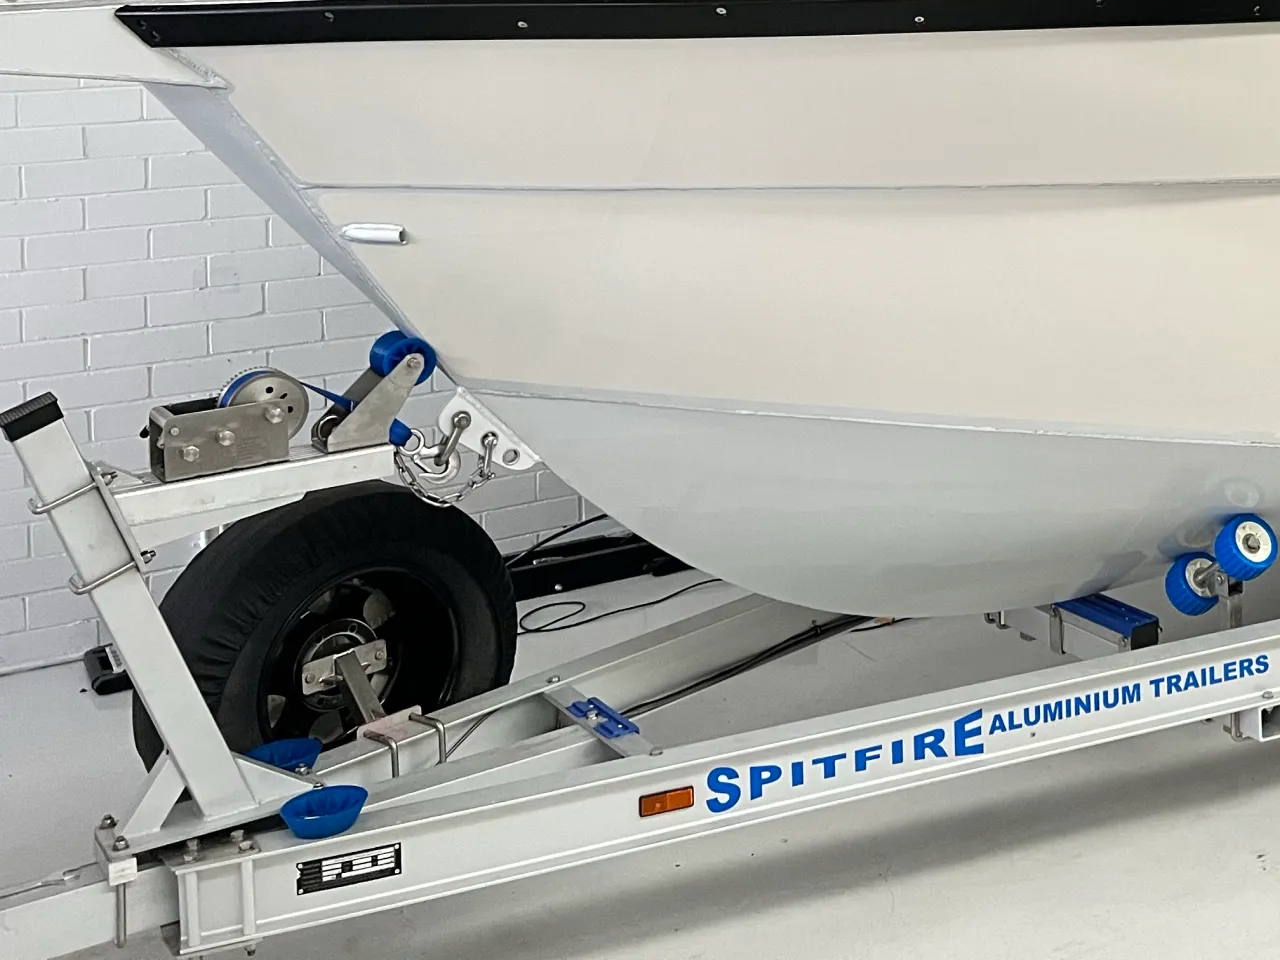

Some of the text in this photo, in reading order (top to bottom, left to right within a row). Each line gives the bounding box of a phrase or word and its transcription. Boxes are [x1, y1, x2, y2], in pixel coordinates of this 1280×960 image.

[706, 654, 1270, 814] SPITFIRE ALUMINIUM TRAILERS
